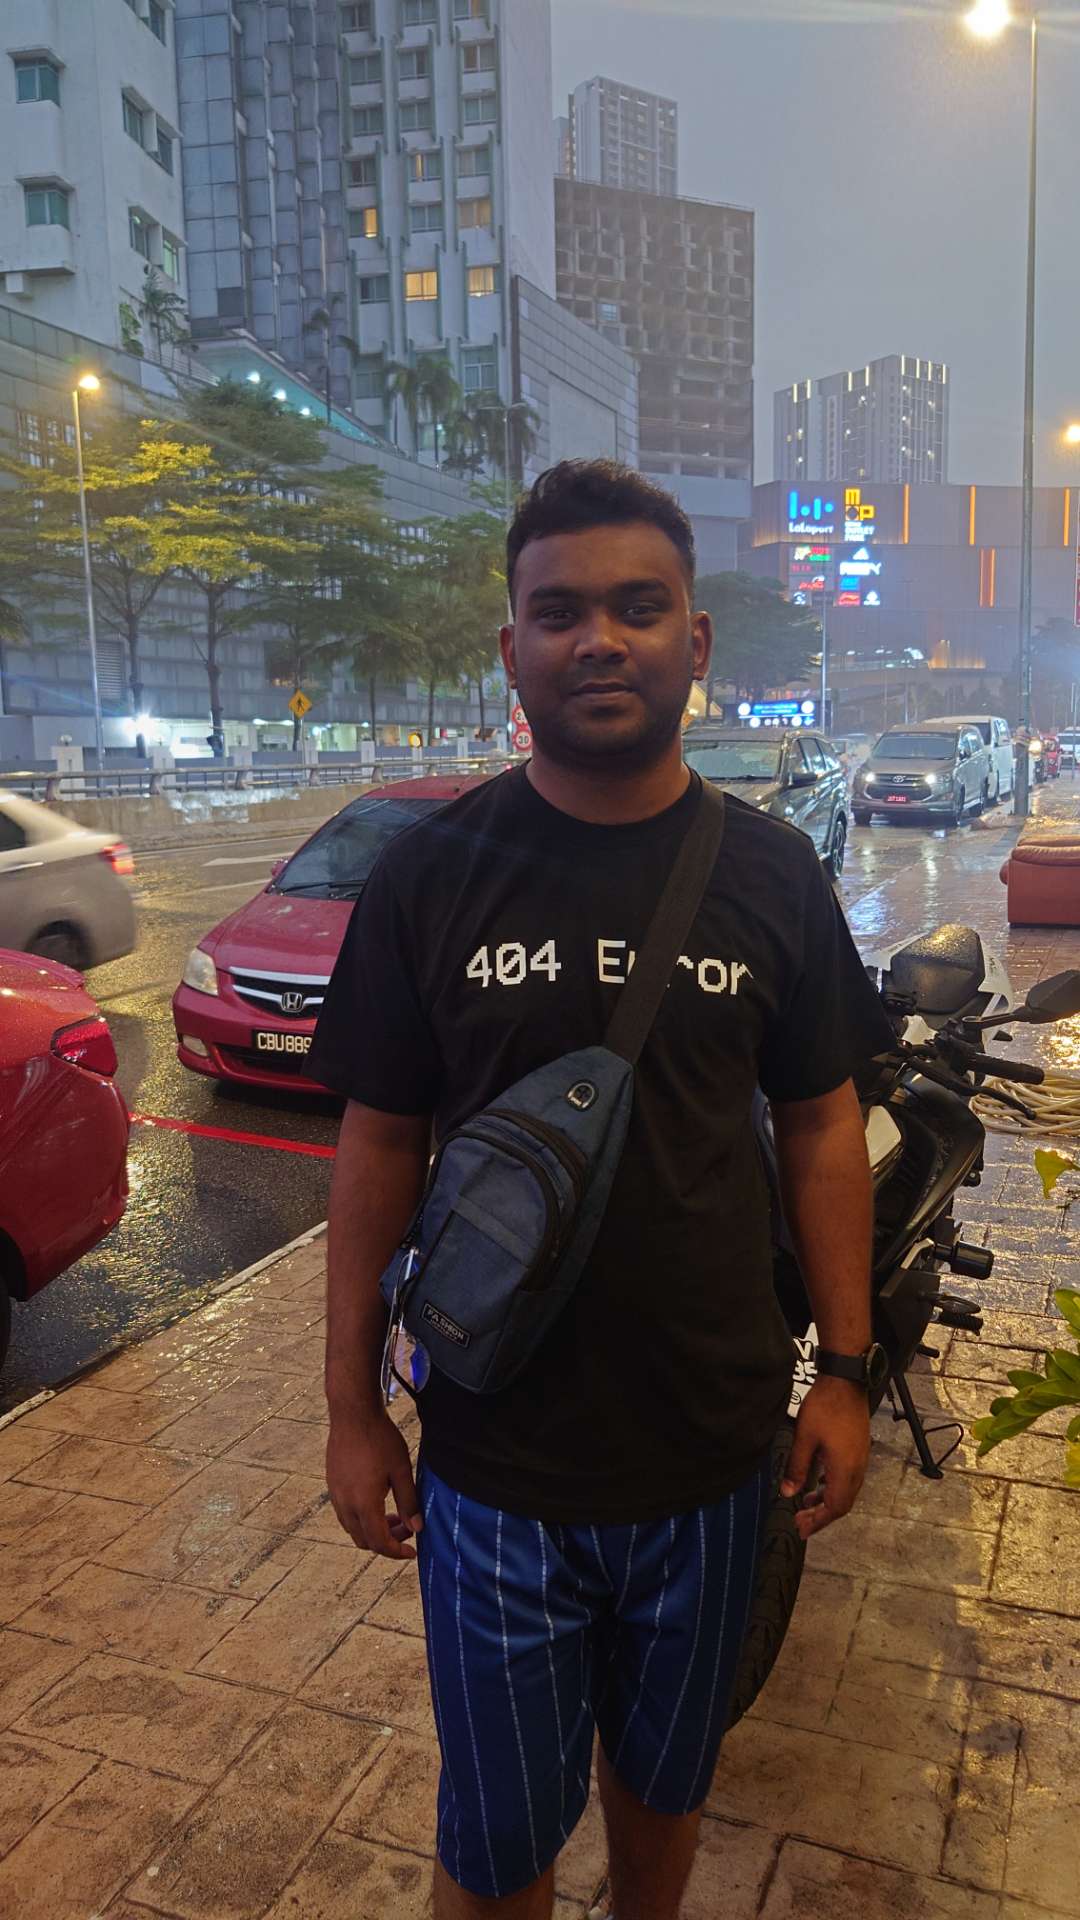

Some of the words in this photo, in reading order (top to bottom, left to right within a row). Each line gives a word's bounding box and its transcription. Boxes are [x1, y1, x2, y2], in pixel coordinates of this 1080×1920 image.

[518, 735, 529, 745] 30
[466, 940, 562, 987] 404
[597, 938, 754, 995] Eor
